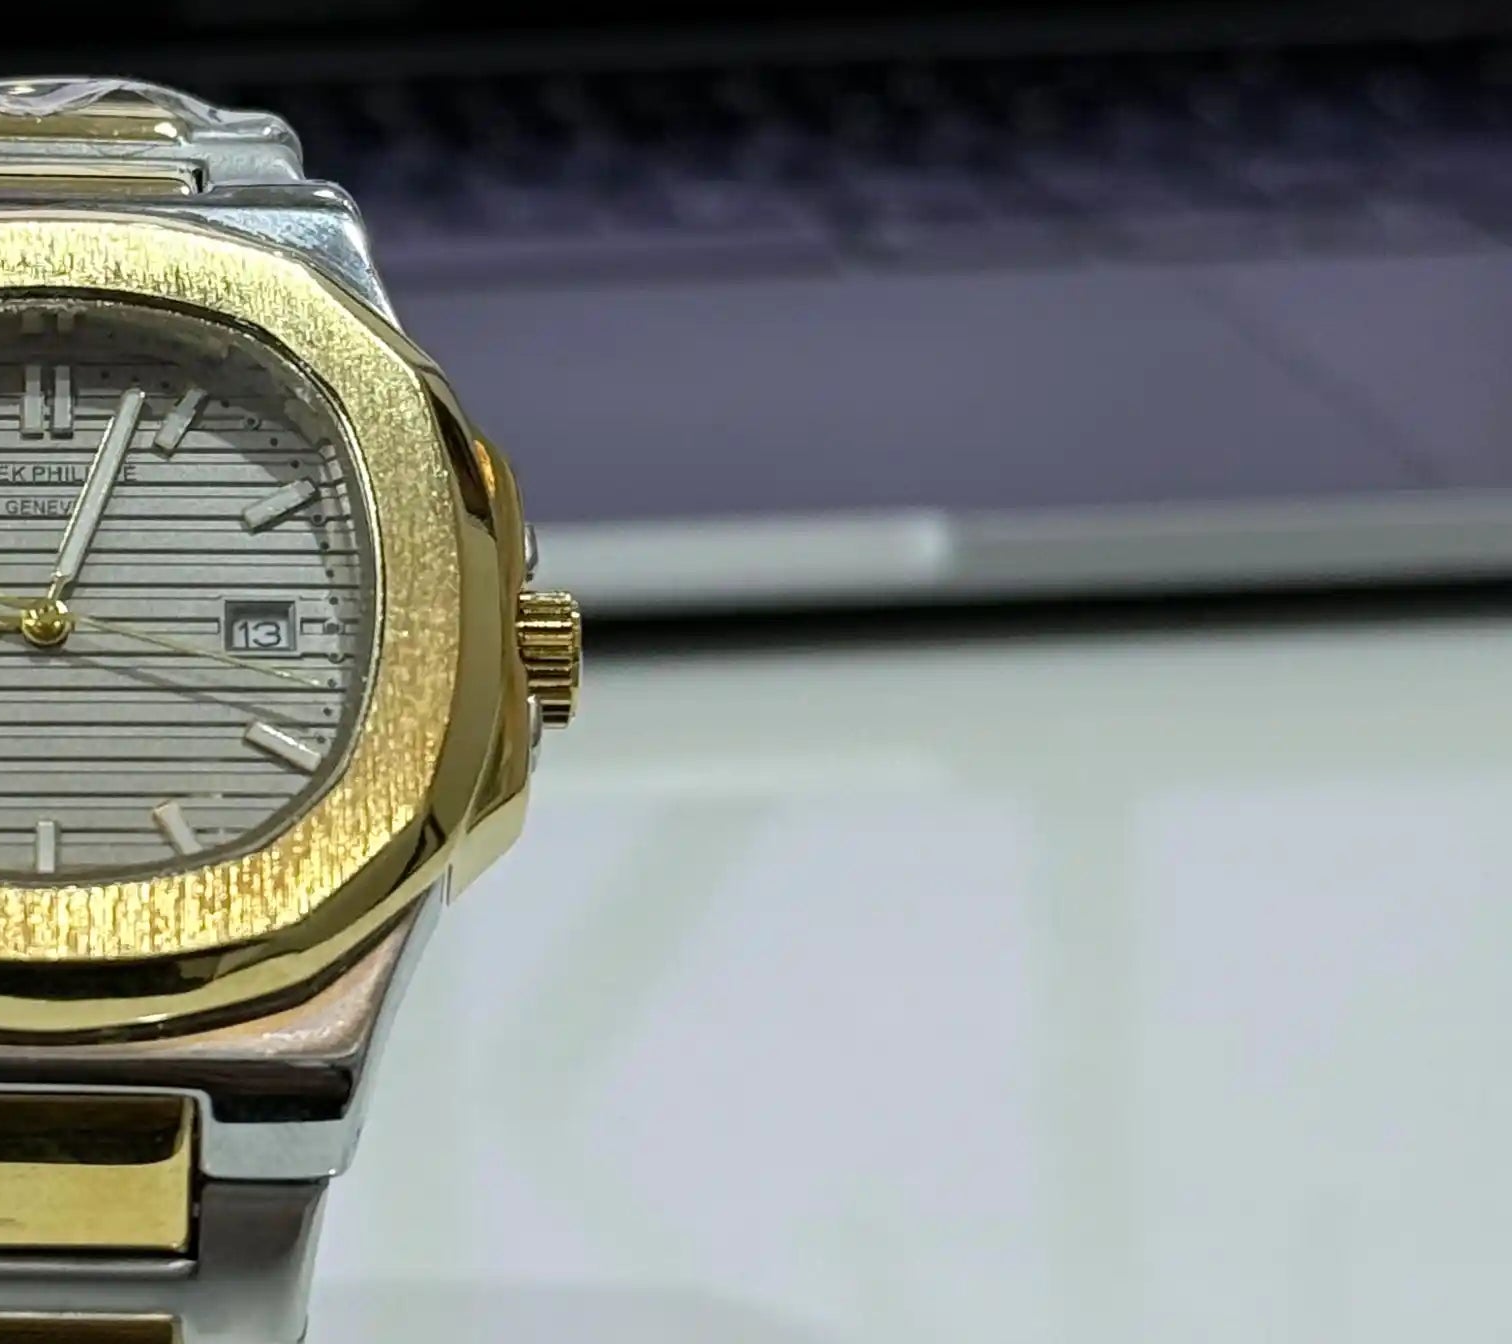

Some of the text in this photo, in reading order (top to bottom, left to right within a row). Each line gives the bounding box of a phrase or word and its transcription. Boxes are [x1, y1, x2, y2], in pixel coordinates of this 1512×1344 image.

[32, 466, 137, 482] PHILIE
[5, 500, 78, 515] GENEV
[238, 620, 281, 648] 13
